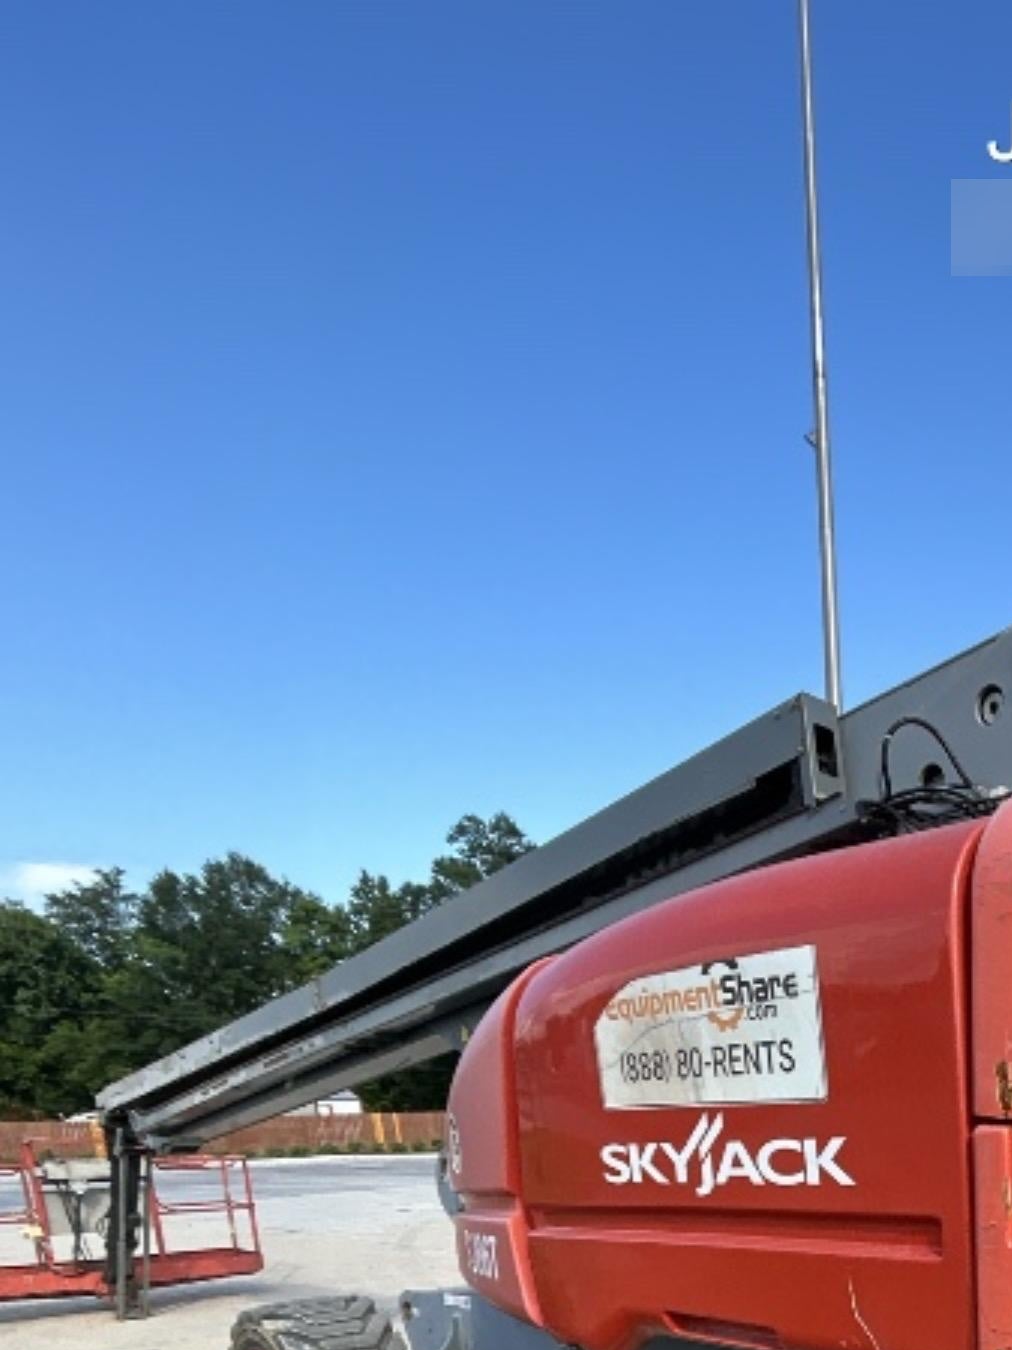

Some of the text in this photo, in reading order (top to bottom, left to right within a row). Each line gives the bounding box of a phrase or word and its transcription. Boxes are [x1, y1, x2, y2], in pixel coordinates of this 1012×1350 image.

[620, 1037, 797, 1084] (888) 80-RENTS
[600, 1111, 857, 1197] SKYJACK
